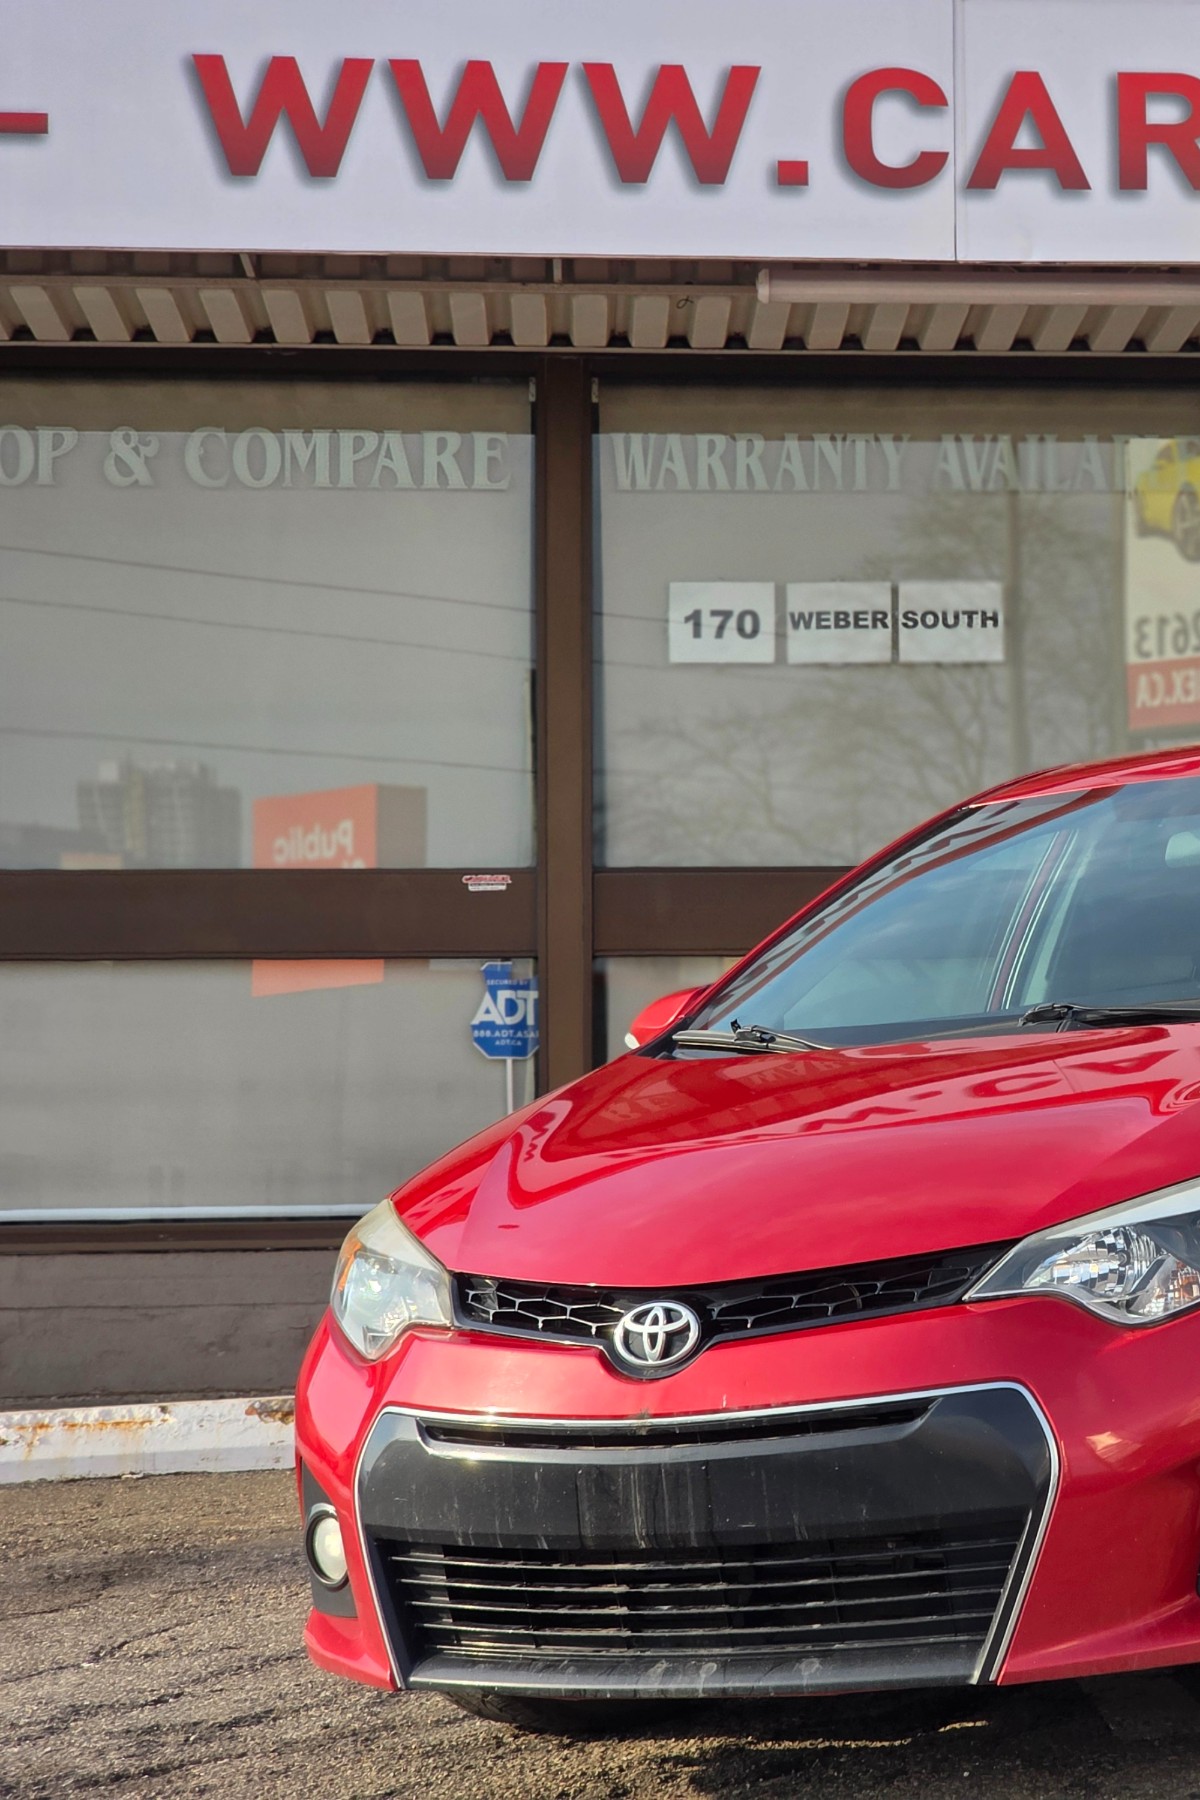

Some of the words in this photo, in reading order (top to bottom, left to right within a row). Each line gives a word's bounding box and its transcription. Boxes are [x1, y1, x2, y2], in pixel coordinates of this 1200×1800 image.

[104, 427, 160, 487] &
[185, 426, 511, 490] COMPARE
[612, 432, 911, 492] WARRANTY
[684, 609, 761, 640] 170
[790, 610, 889, 631] WEBER
[901, 610, 999, 630] SOUTH
[470, 989, 539, 1025] ADT
